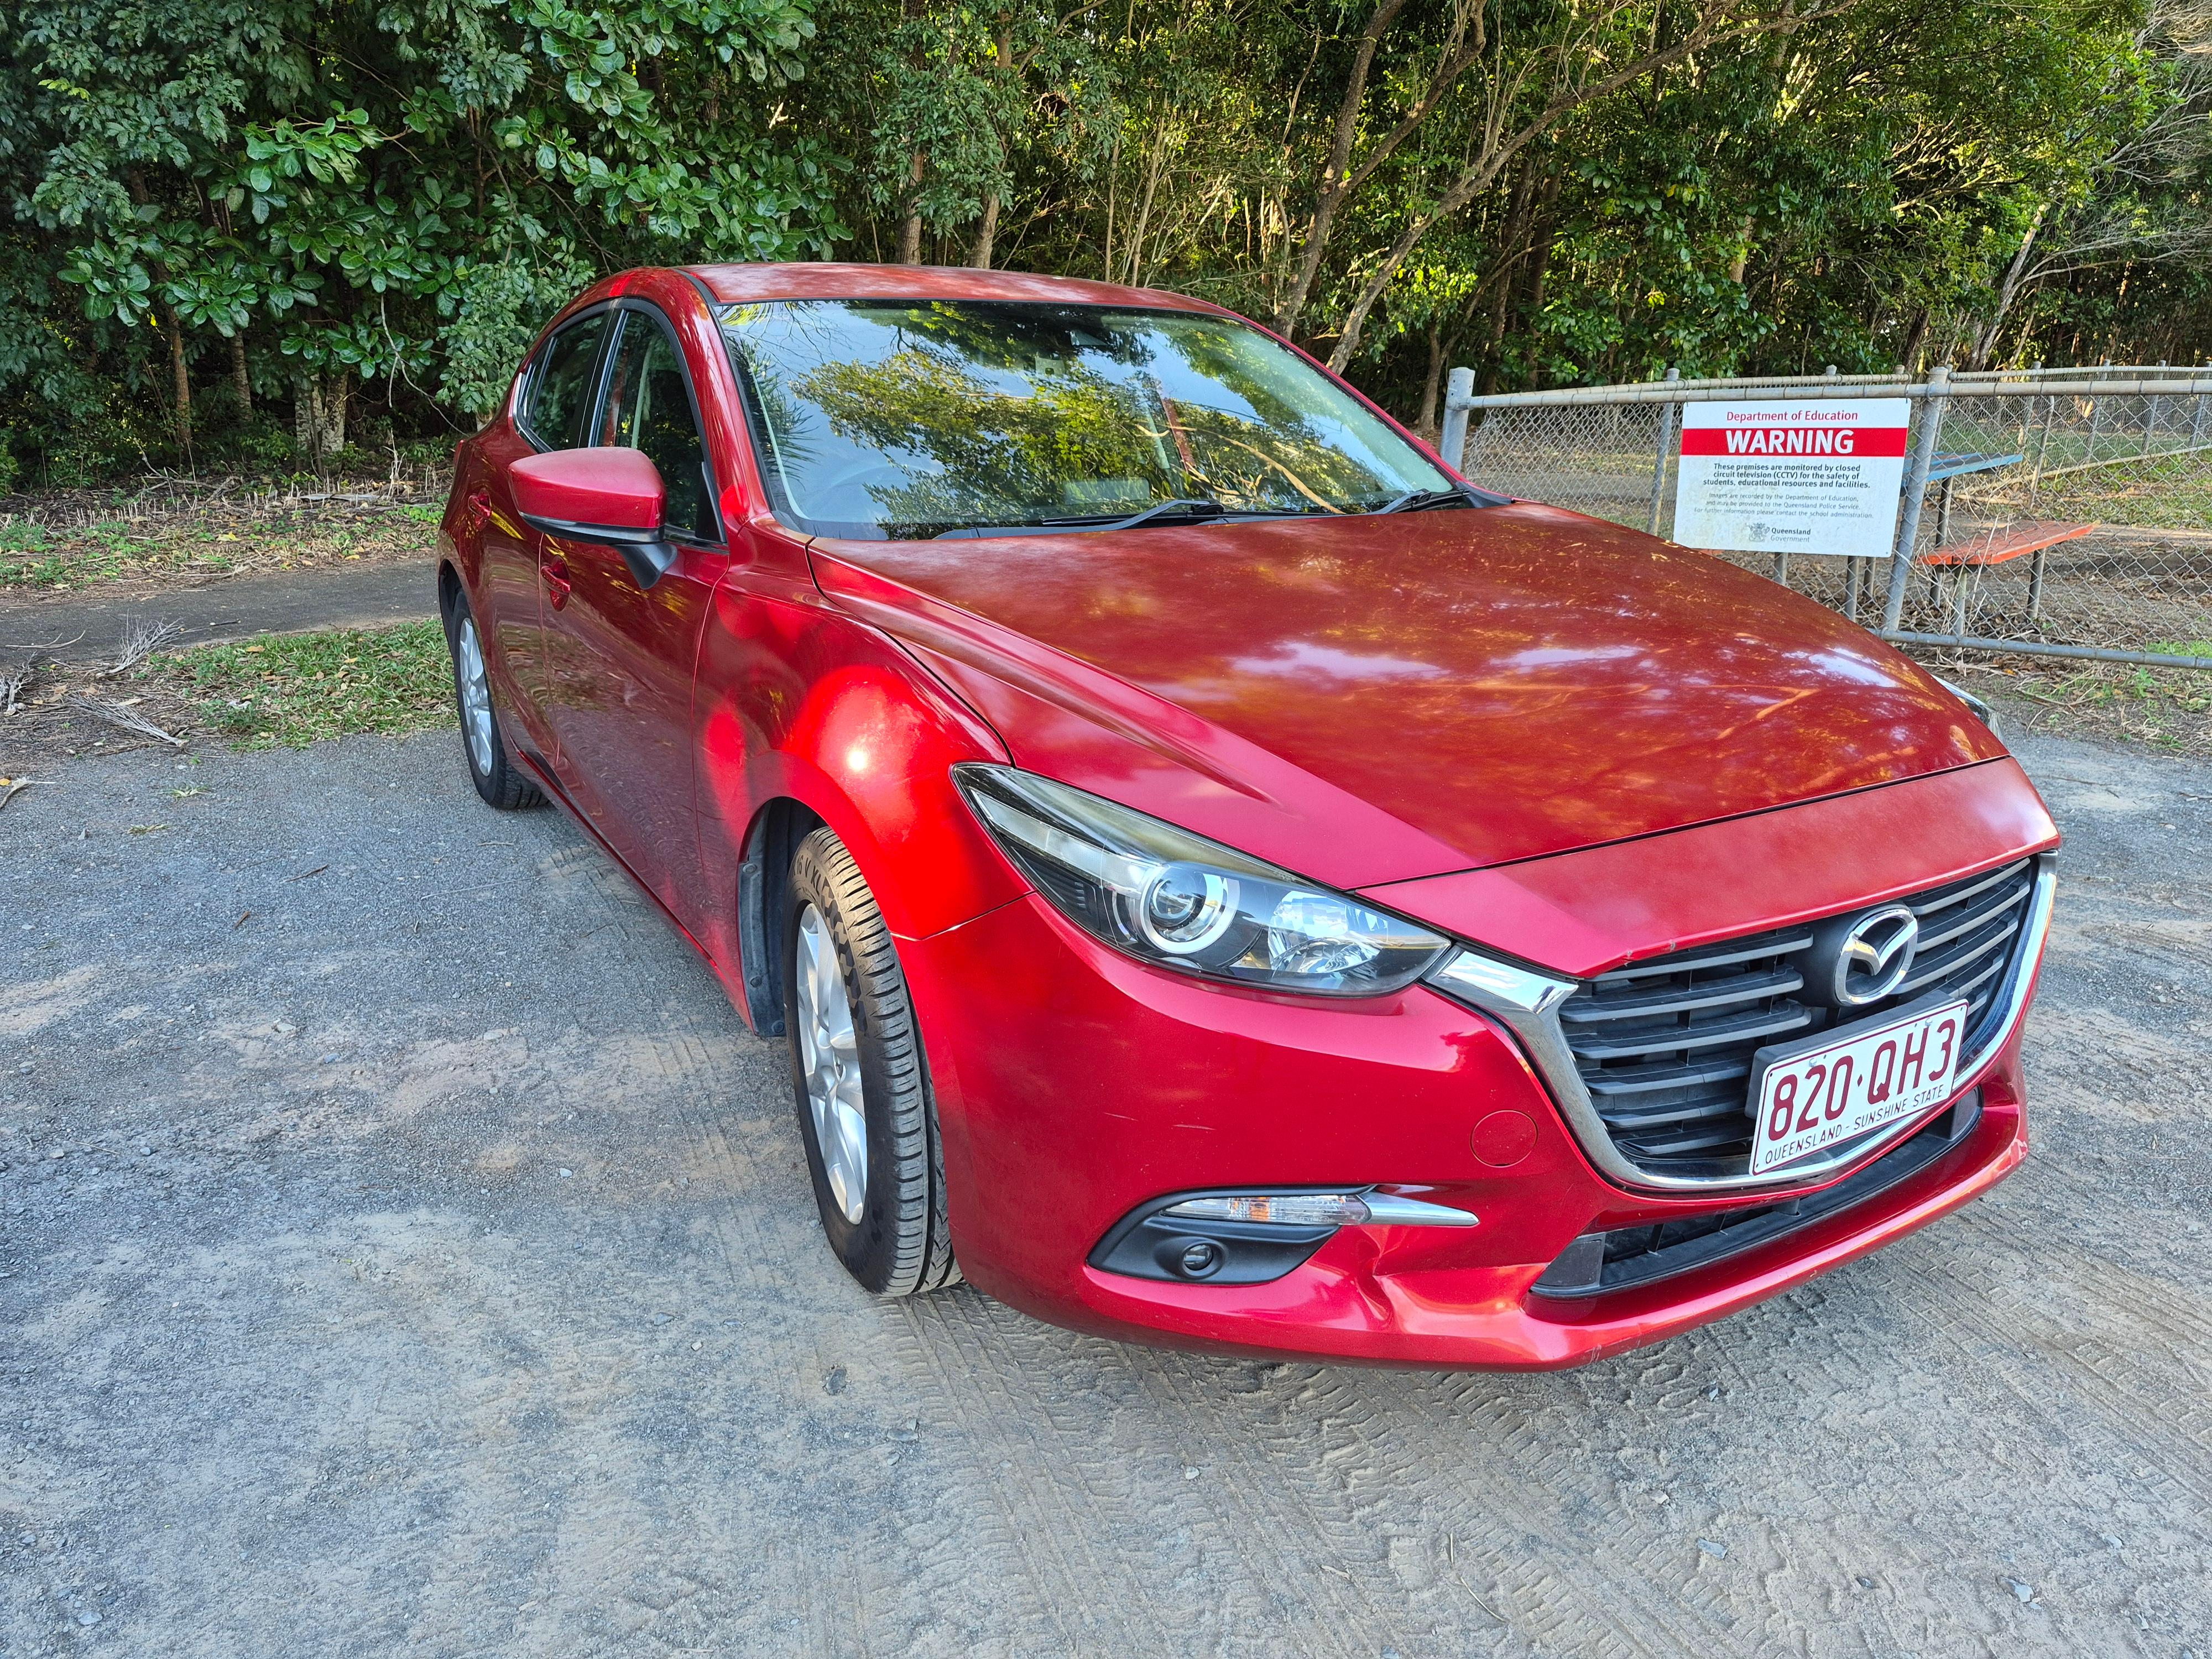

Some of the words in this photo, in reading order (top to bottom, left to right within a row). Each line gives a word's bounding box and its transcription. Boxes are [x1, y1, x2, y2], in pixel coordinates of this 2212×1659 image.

[1726, 411, 1788, 423] Department
[1791, 410, 1803, 420] of
[1804, 410, 1858, 420] Education
[1725, 429, 1854, 454] WARNING
[1824, 464, 1834, 473] by
[1773, 471, 1797, 479] (CCTV)
[1826, 472, 1850, 481] safety
[1771, 527, 1811, 535] Queensland
[1765, 1123, 1842, 1165] QUEENSLAND
[1854, 1098, 1907, 1130] SUNSHINE
[1913, 1084, 1944, 1107] STATE
